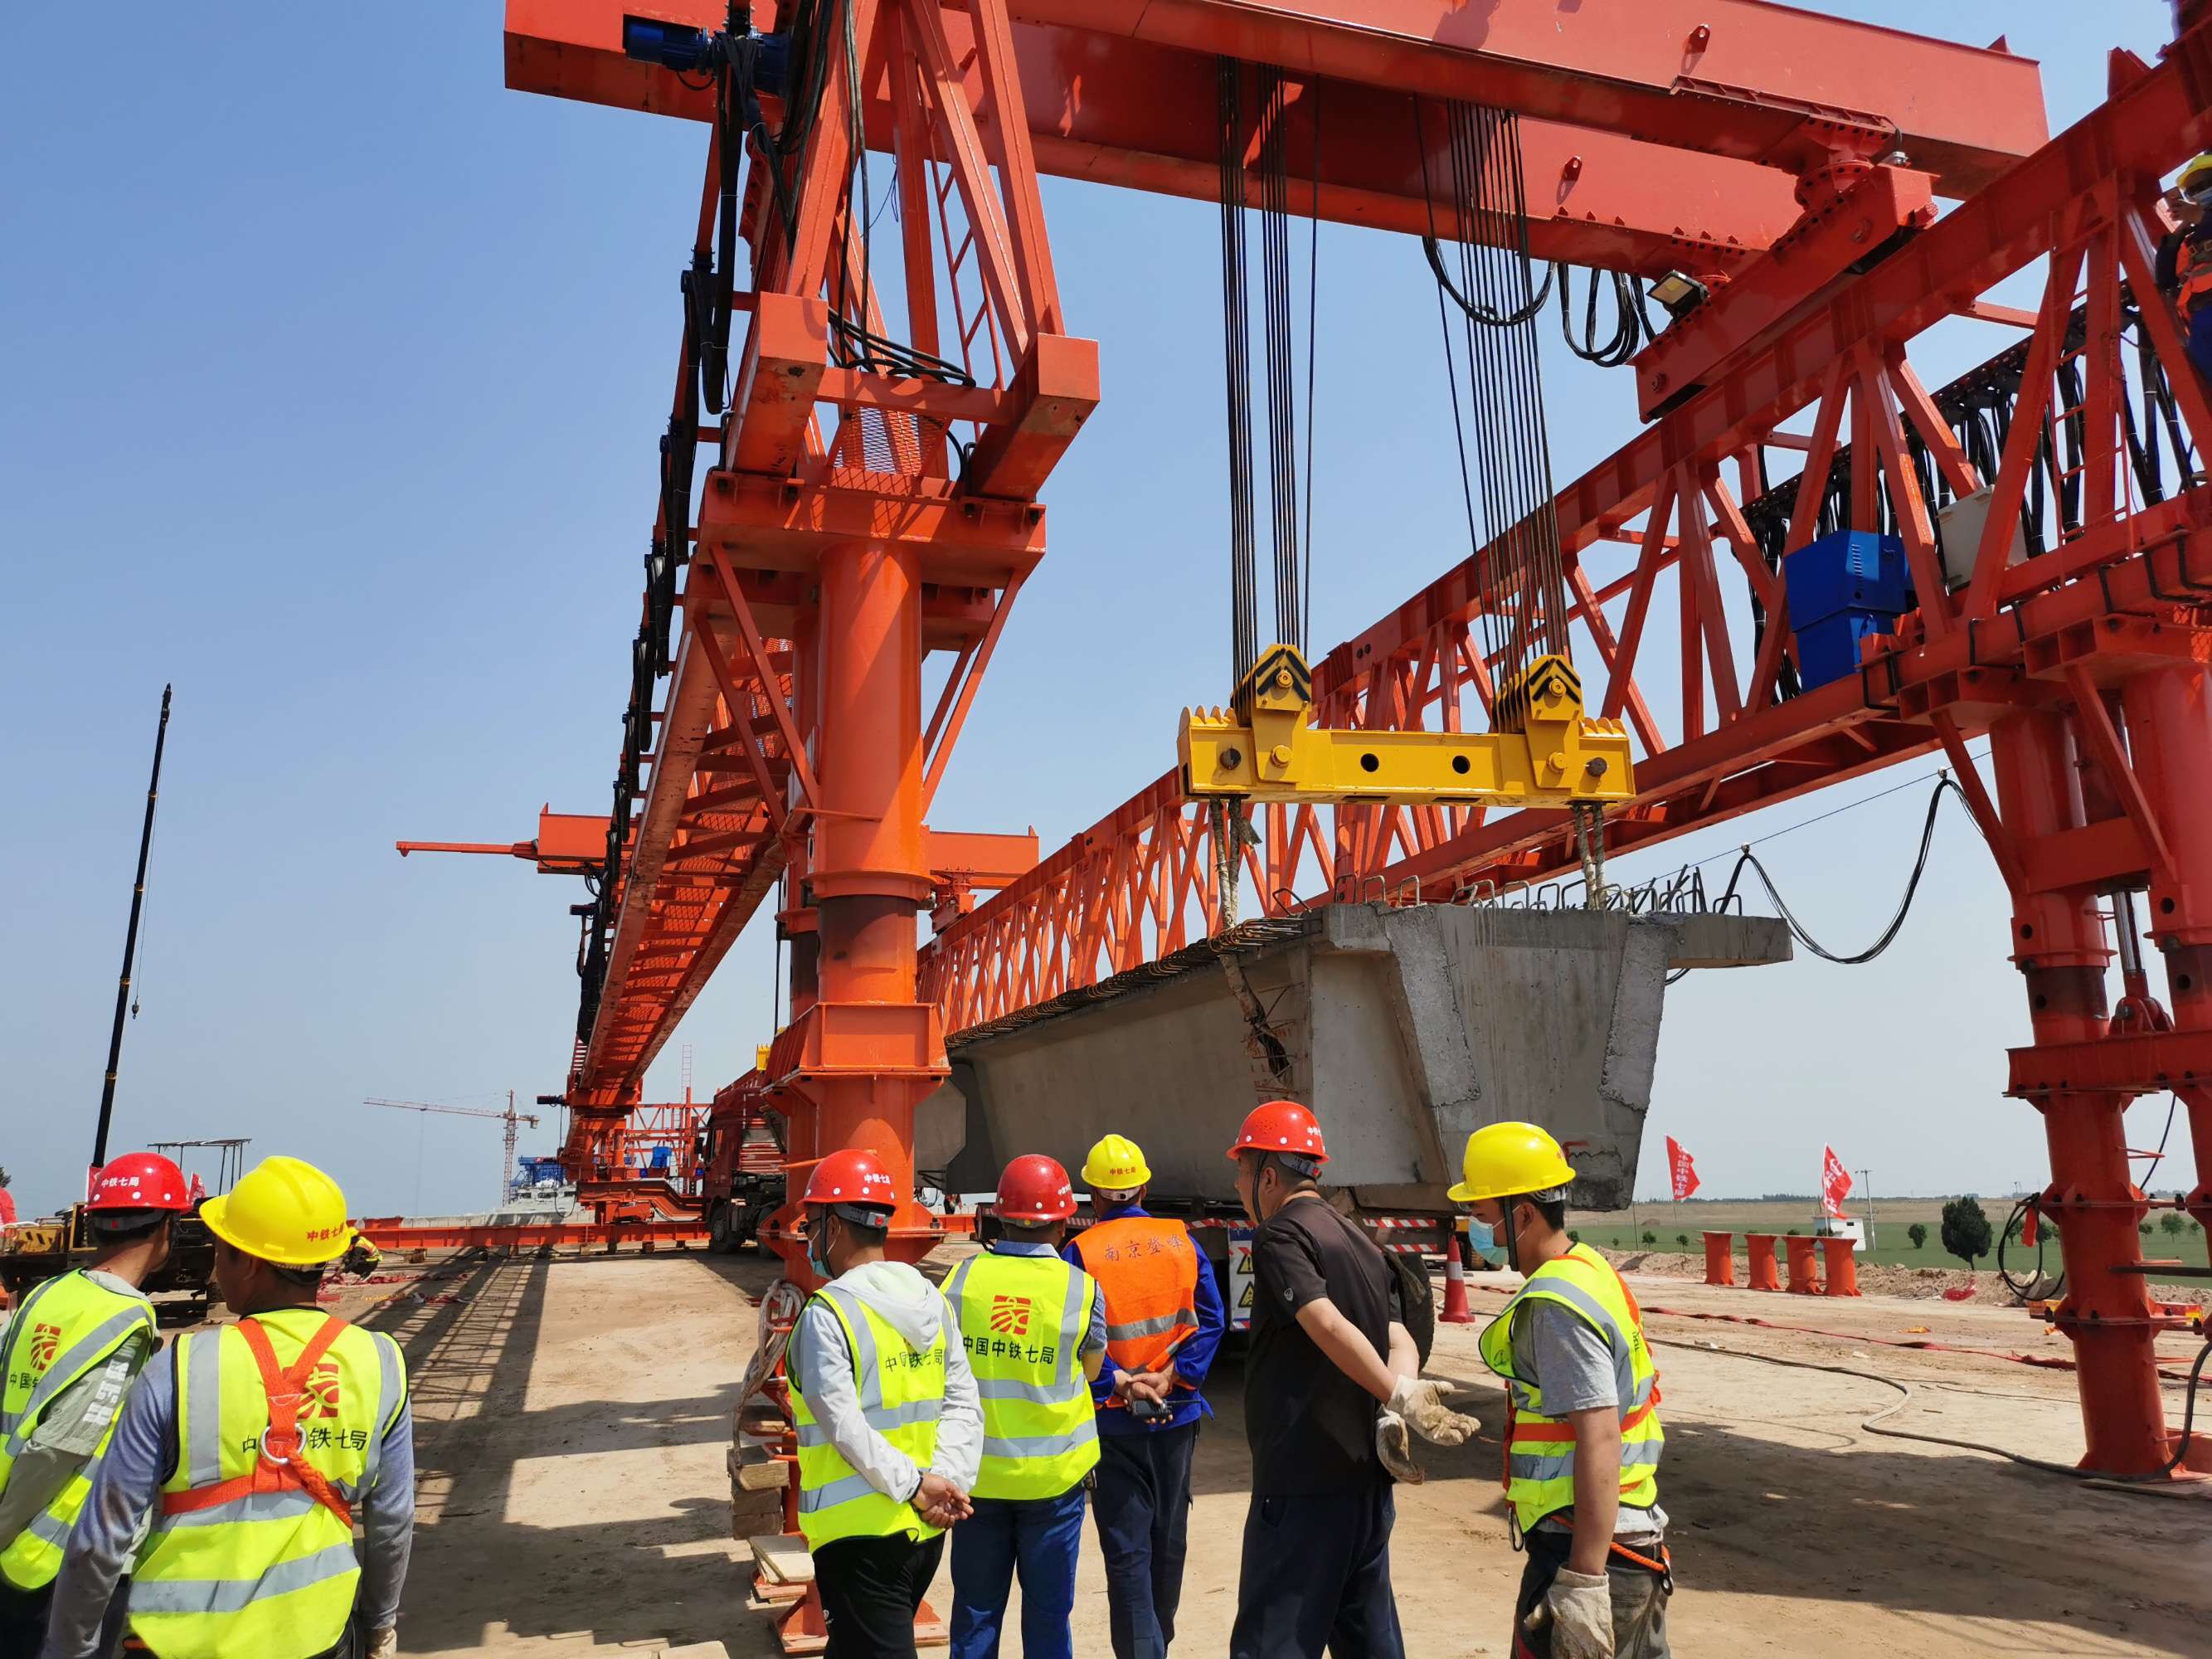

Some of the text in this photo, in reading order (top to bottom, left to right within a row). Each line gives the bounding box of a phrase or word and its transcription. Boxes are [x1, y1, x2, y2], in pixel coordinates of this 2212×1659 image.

[101, 1177, 139, 1188] 中铁七局
[963, 1335, 1054, 1365] 中国中铁七局
